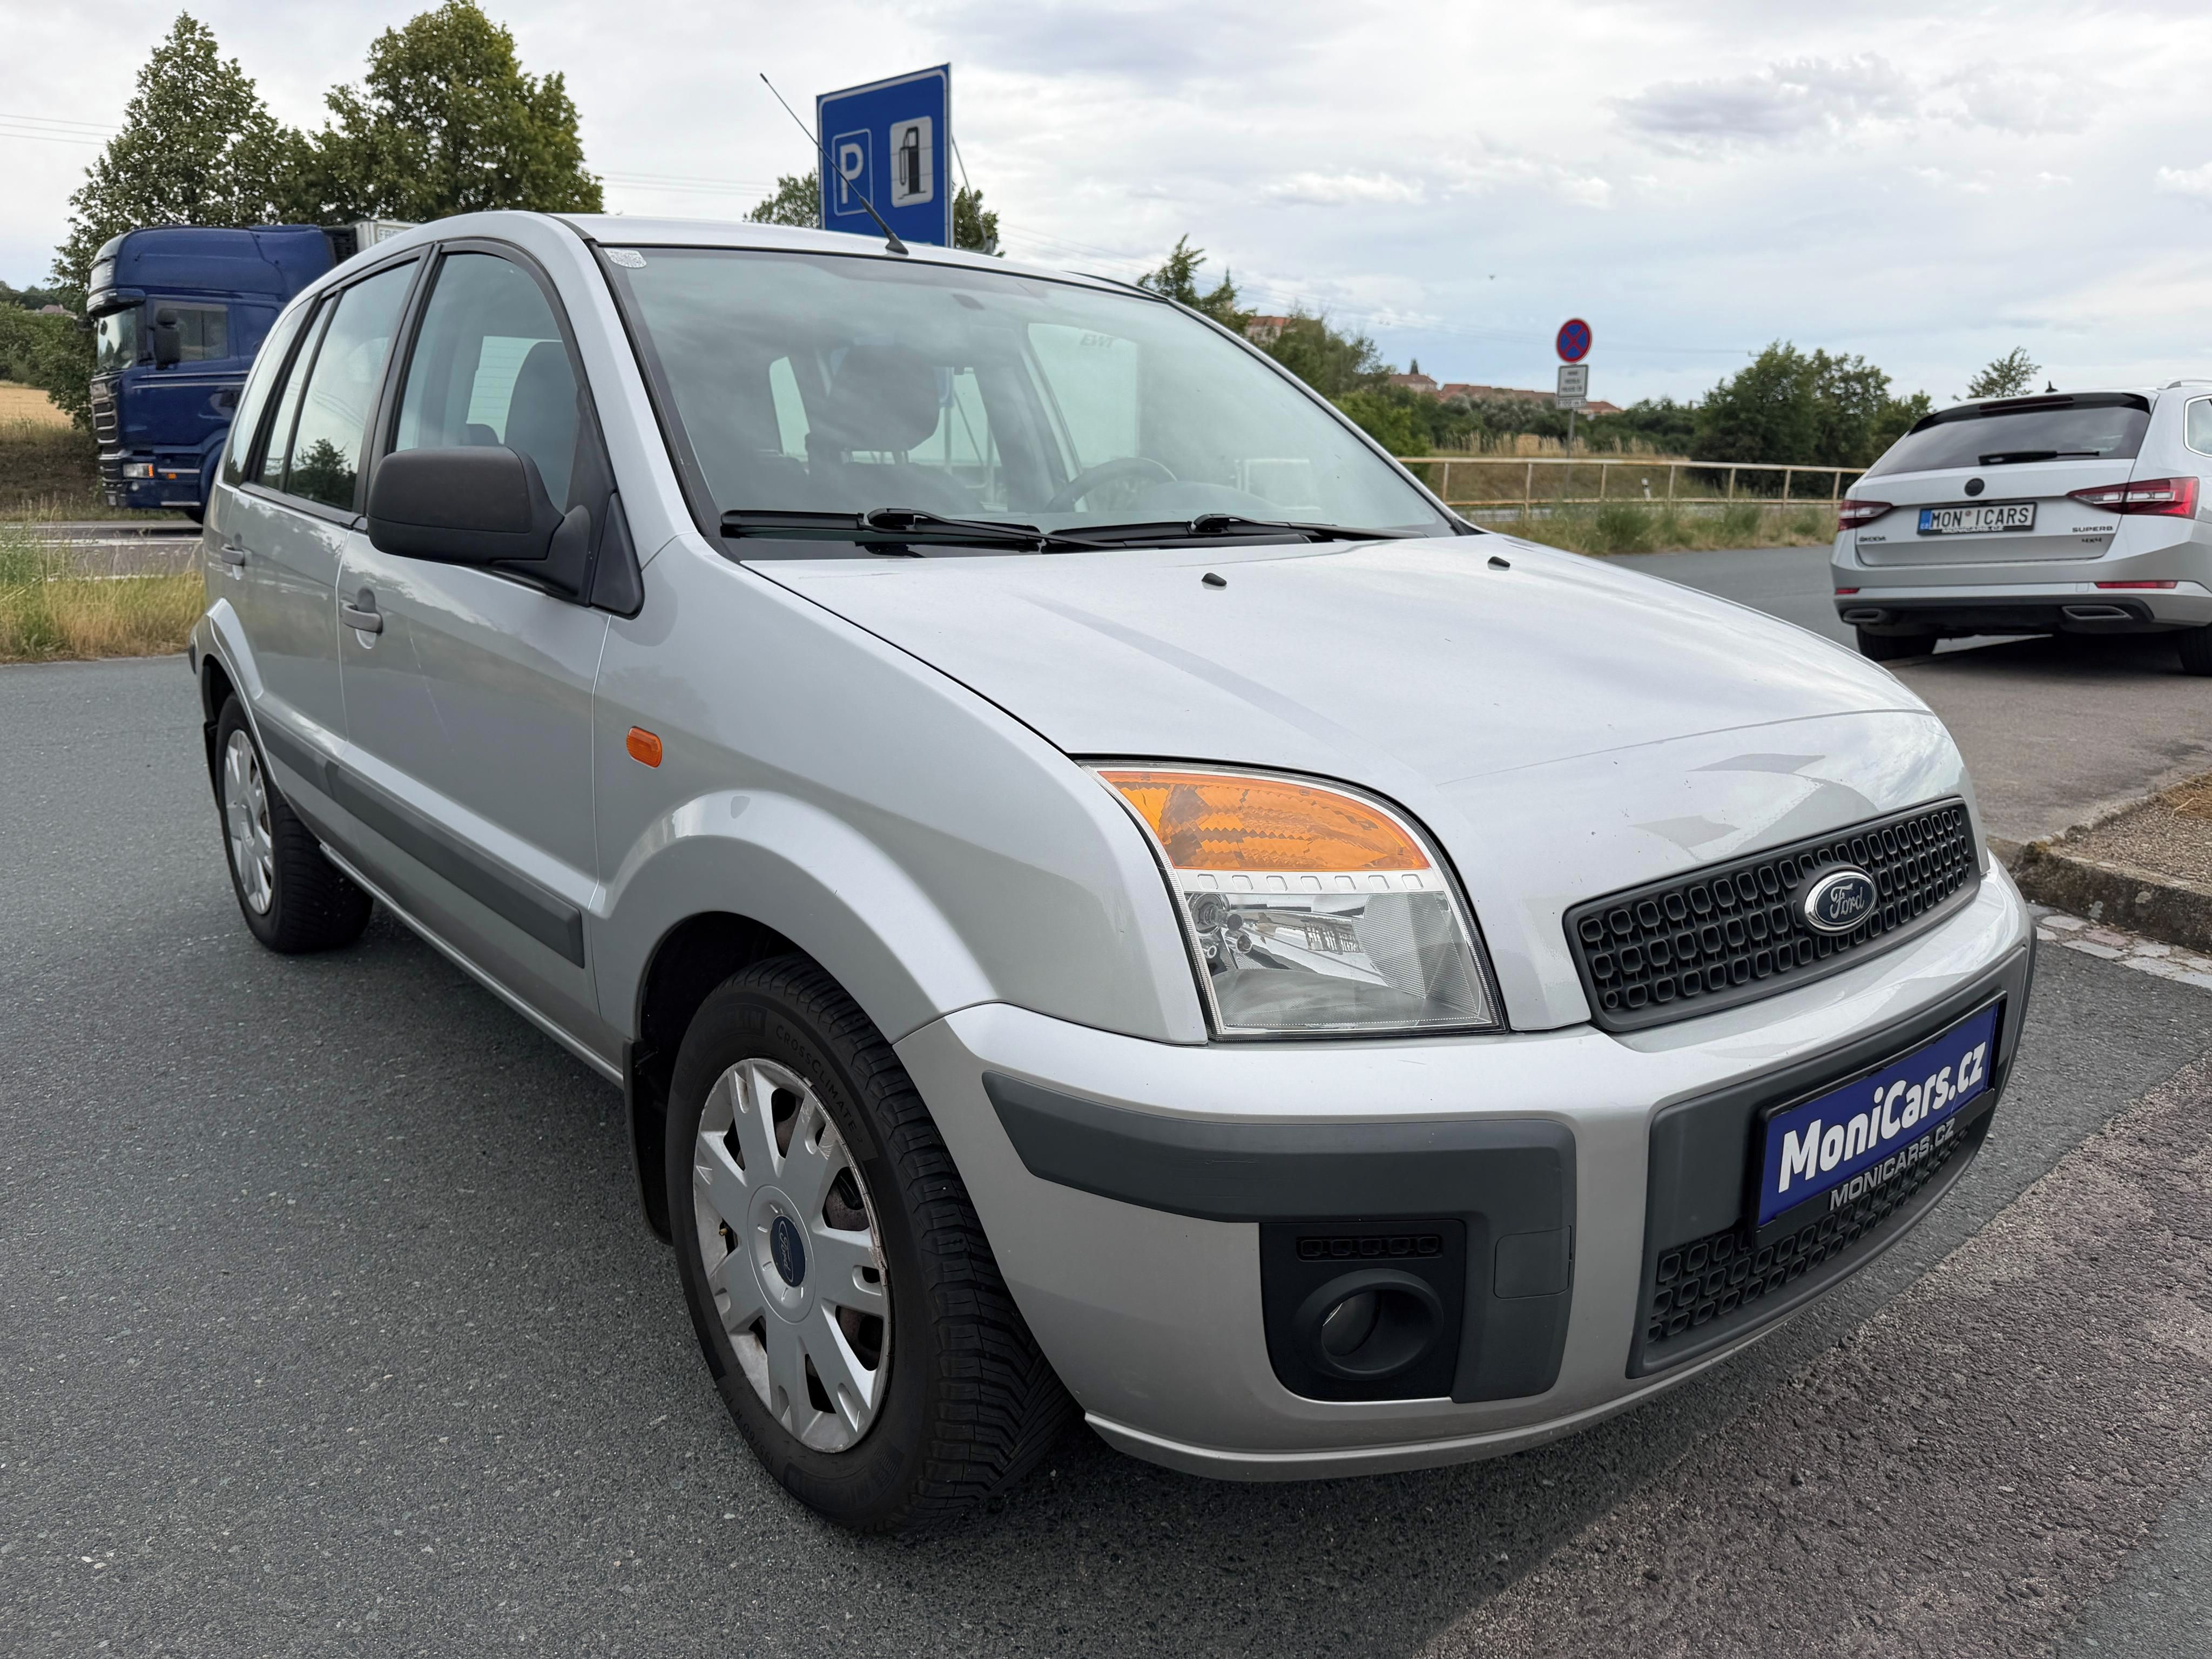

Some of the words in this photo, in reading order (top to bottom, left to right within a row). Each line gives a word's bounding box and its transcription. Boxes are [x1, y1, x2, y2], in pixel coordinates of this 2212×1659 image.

[840, 143, 864, 205] P
[1830, 883, 1865, 919] Ford
[776, 1025, 857, 1132] CROSSCLIMATE
[1778, 1041, 1986, 1193] MoniCars.cz
[1830, 1117, 1955, 1211] MONICARS.CZ
[780, 1232, 791, 1271] Ford
